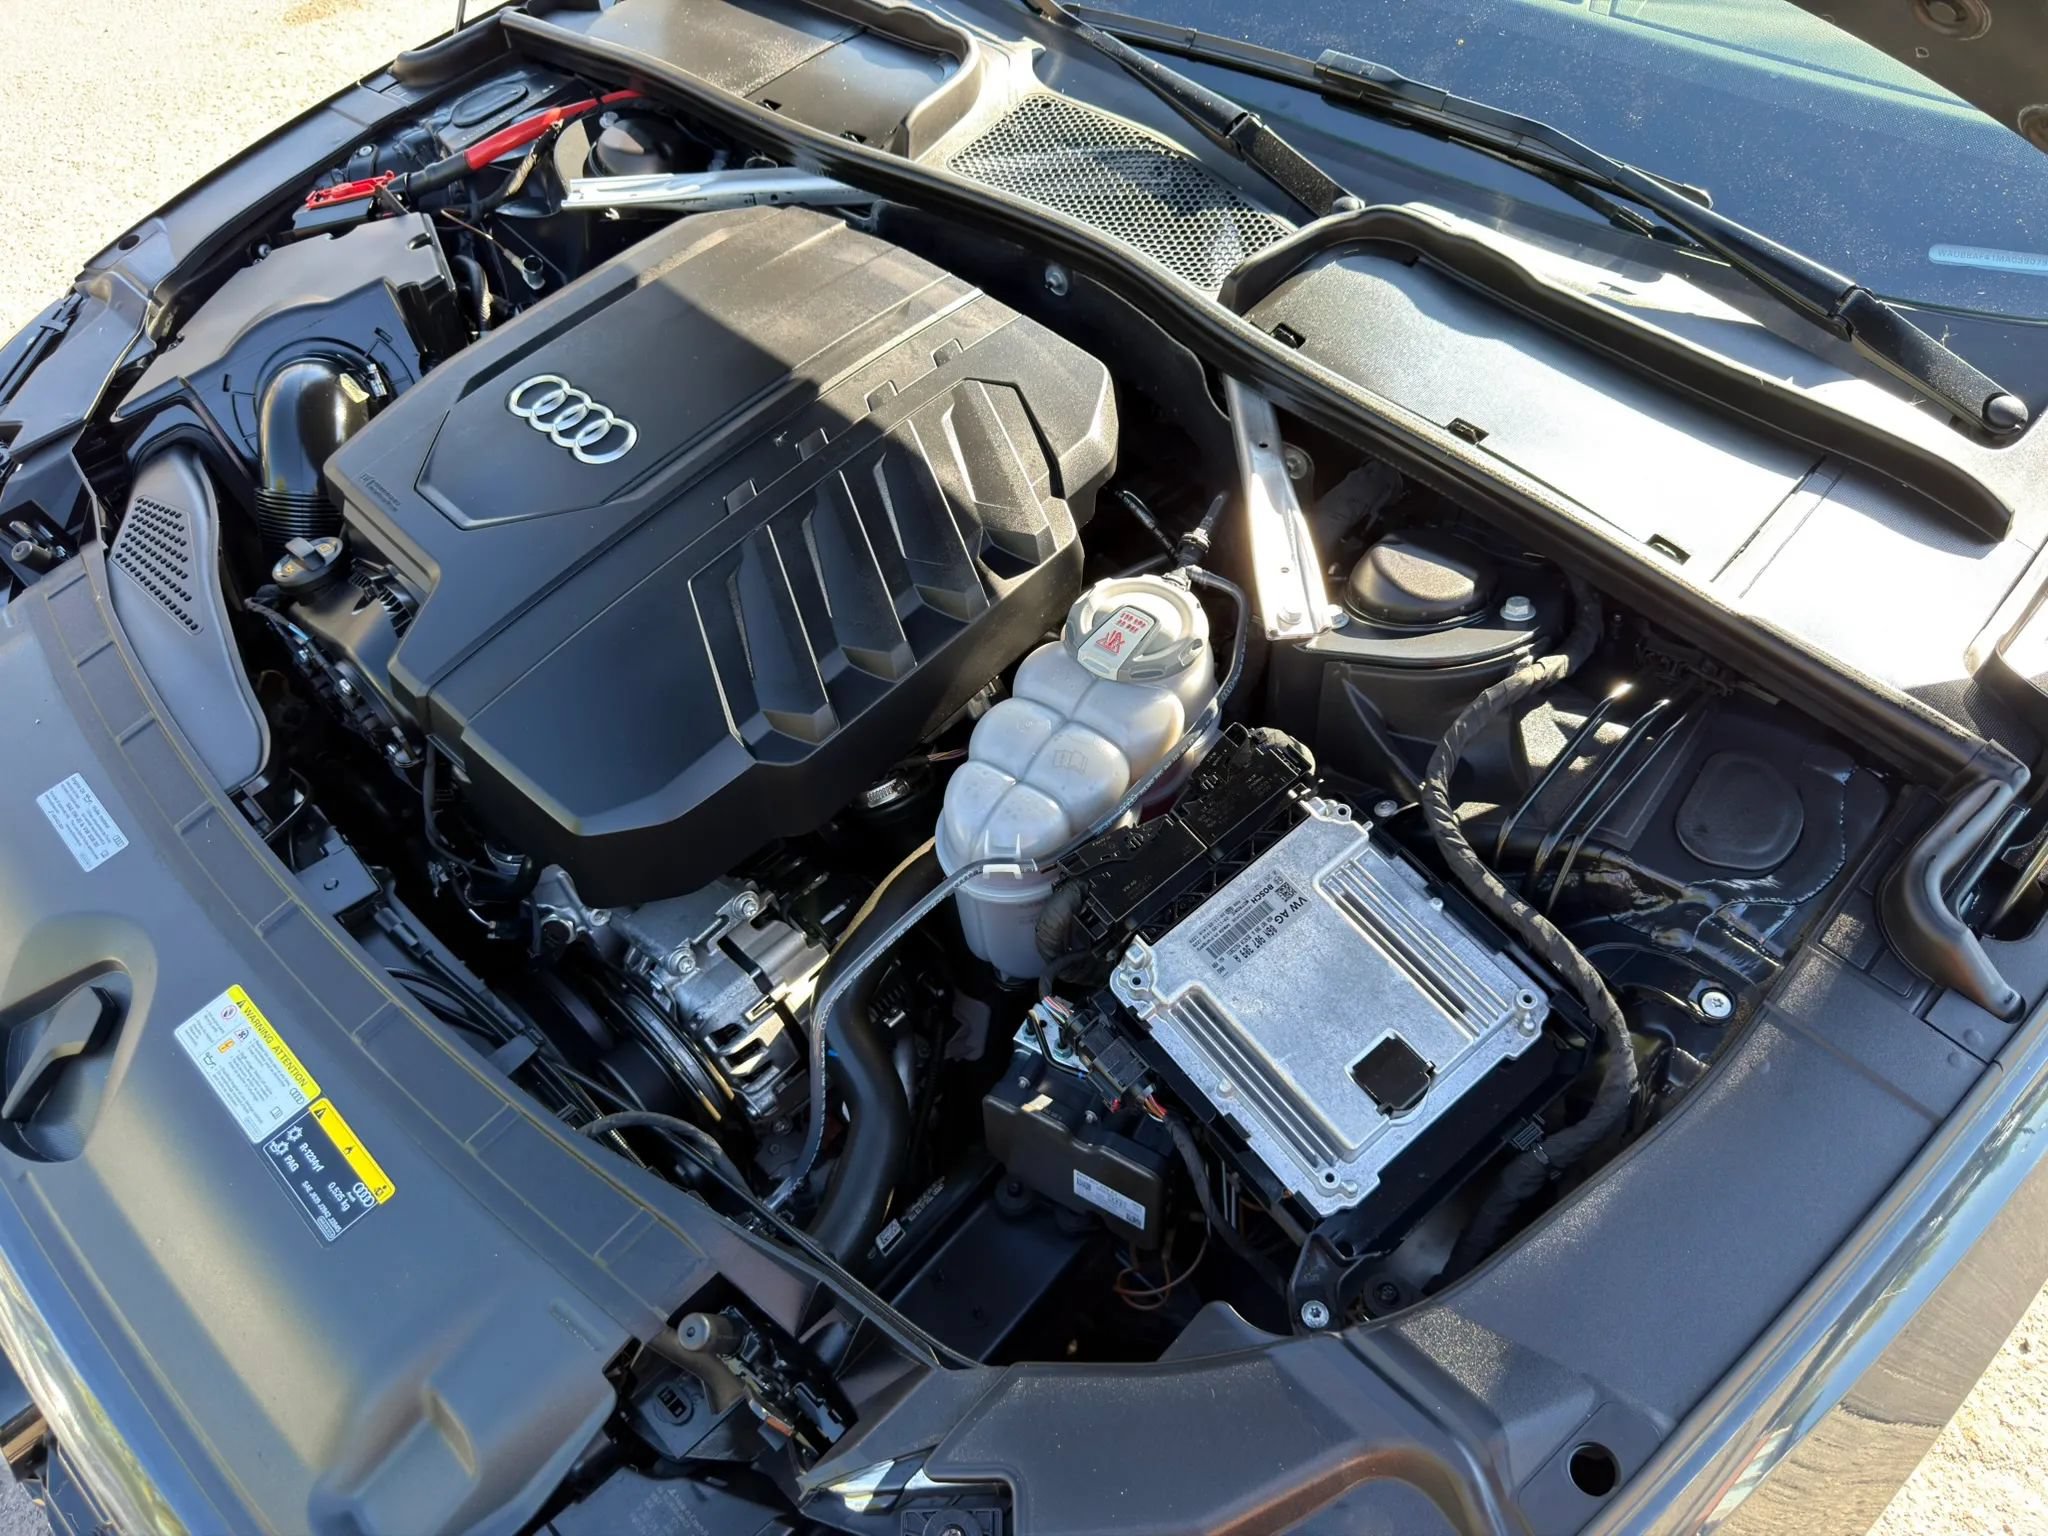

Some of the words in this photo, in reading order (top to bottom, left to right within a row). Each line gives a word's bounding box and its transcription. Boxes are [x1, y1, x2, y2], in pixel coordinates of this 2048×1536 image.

[1250, 883, 1273, 903] BOSCH
[1288, 894, 1307, 912] VW
[1273, 909, 1289, 924] AG
[1251, 934, 1265, 948] 907
[1232, 953, 1242, 964] A
[243, 1007, 274, 1043] WARNING
[272, 1044, 307, 1086] ATTENTION
[283, 1154, 299, 1172] PAG
[297, 1142, 324, 1173] R-1234yf
[301, 1179, 313, 1193] SAE
[326, 1181, 345, 1201] 0,525
[338, 1199, 352, 1212] kg
